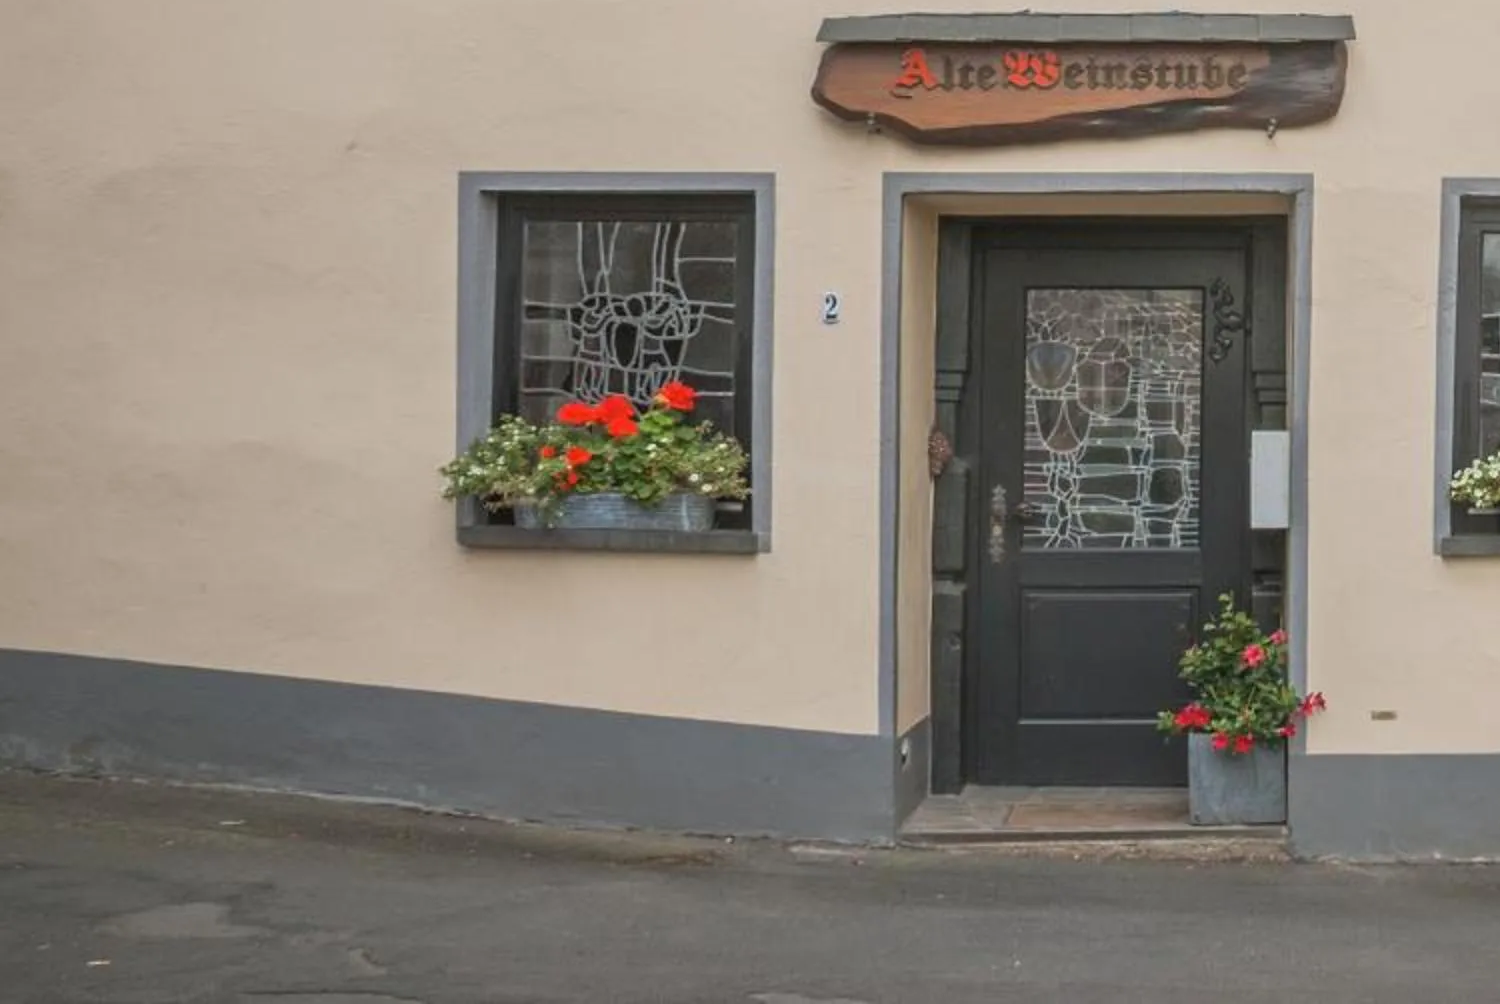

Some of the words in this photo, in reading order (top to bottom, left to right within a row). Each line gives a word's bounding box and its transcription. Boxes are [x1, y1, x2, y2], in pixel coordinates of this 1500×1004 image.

[894, 48, 997, 92] Alte
[1002, 50, 1249, 91] Weinstube
[825, 293, 838, 319] 2
